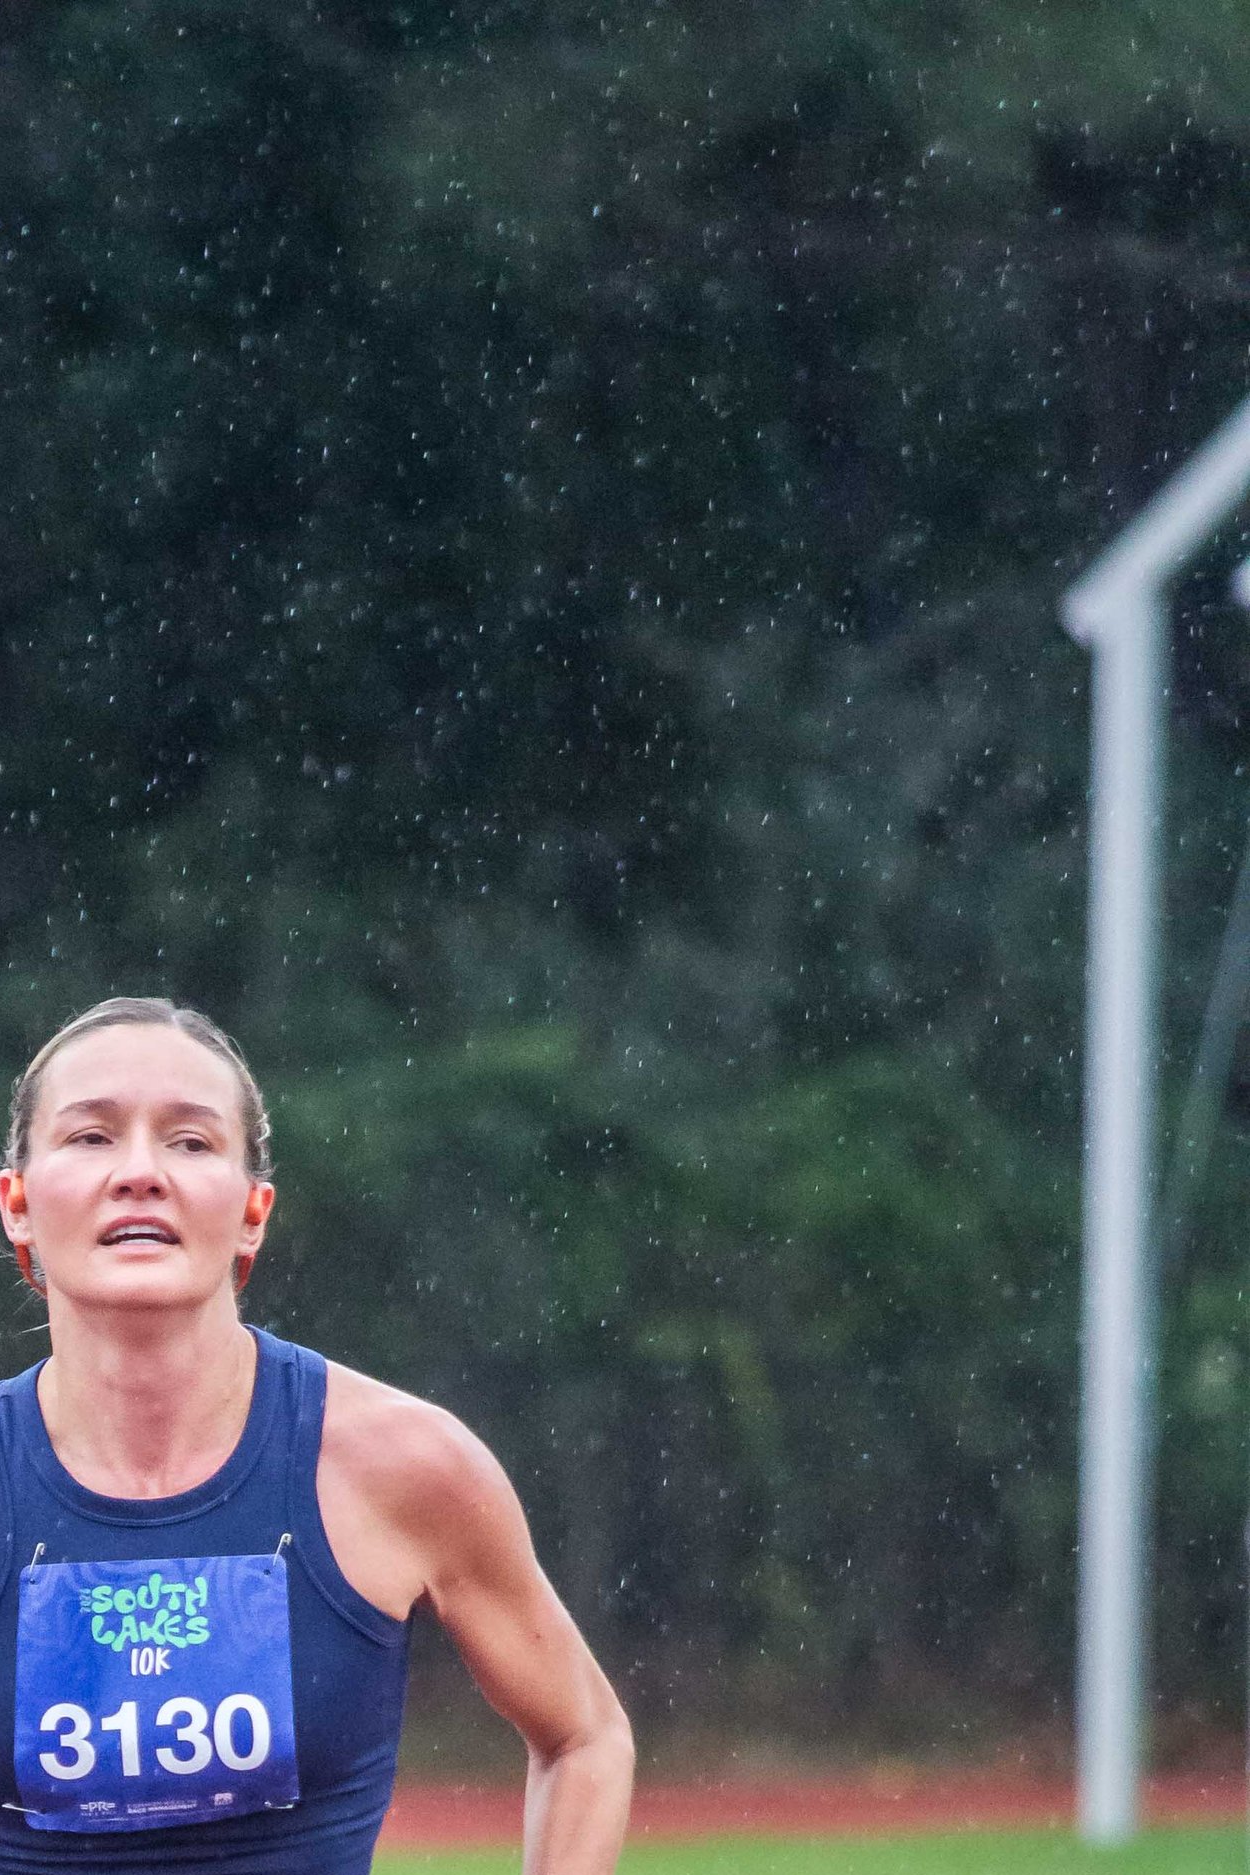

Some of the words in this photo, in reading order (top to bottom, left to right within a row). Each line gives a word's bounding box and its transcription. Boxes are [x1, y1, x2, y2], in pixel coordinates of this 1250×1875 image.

[91, 1573, 208, 1616] SOUTH
[91, 1609, 210, 1652] LAKES
[130, 1647, 171, 1676] 10K
[39, 1693, 271, 1781] 3130
